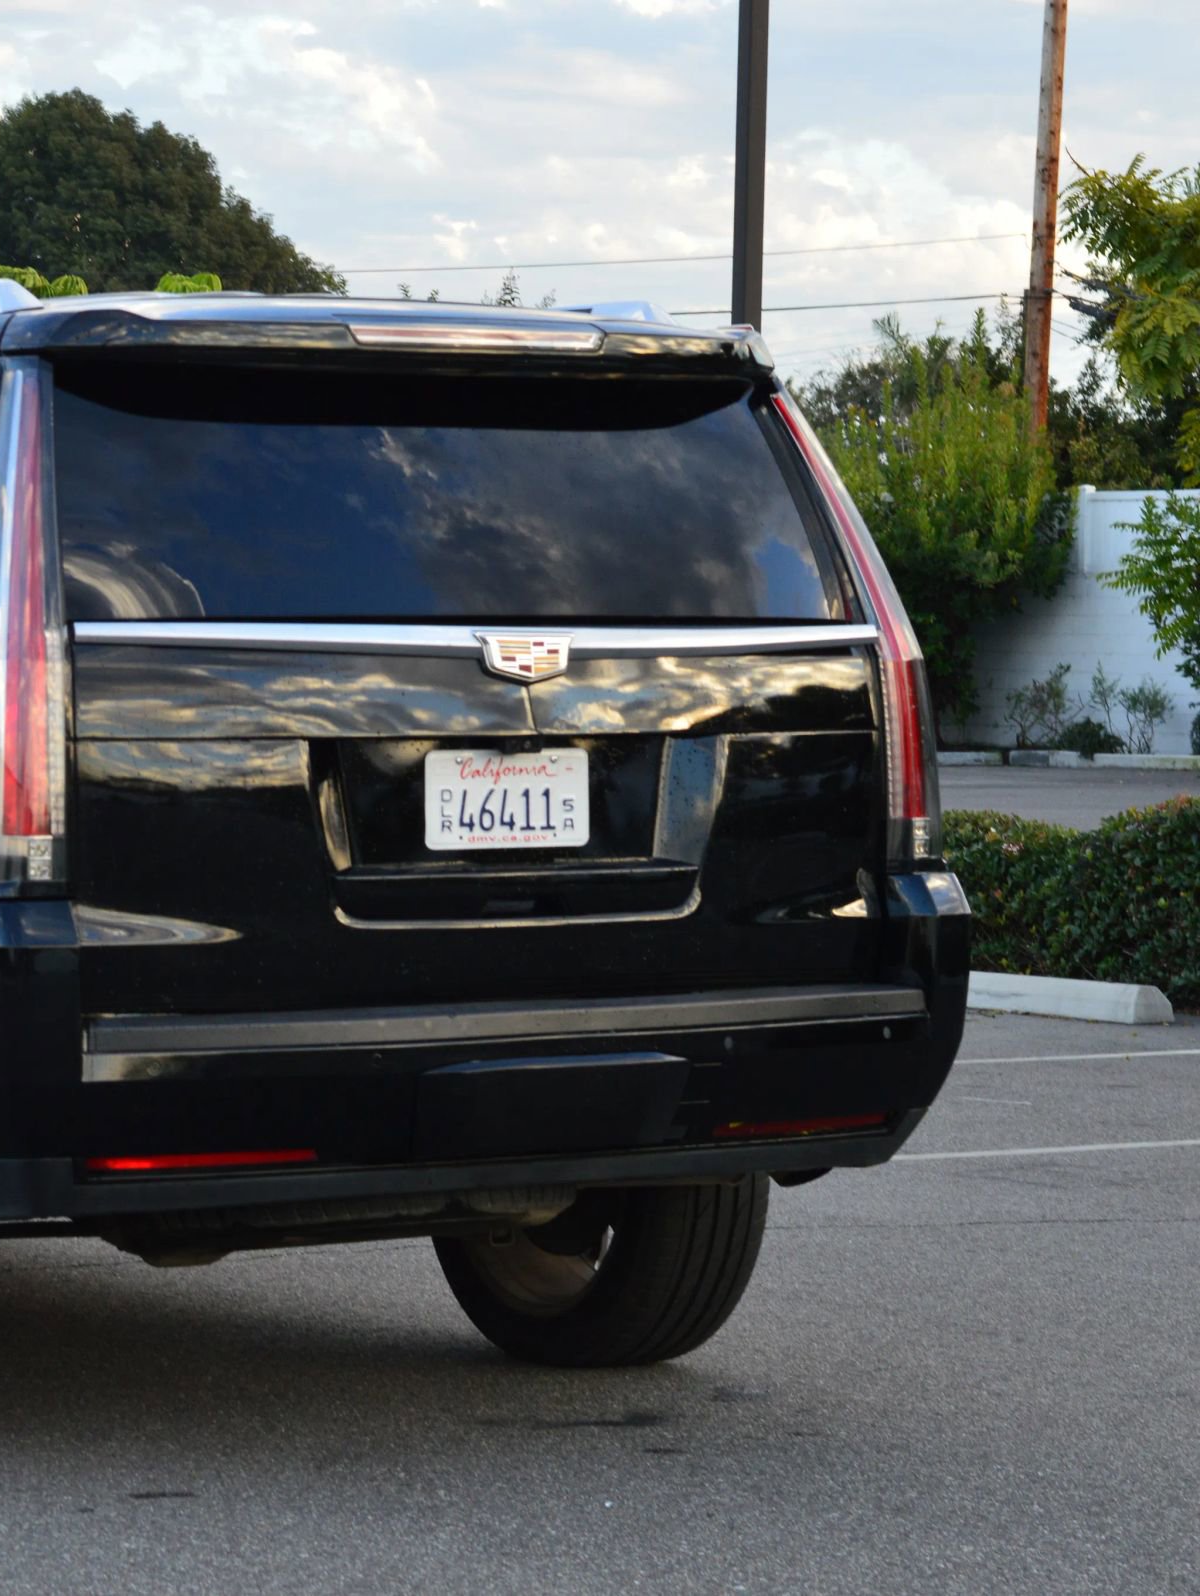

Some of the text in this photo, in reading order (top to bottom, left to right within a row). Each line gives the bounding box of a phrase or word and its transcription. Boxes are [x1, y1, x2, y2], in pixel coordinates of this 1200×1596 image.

[460, 756, 557, 785] California
[458, 787, 556, 833] 46411
[467, 833, 550, 844] dmv.ca.gov
